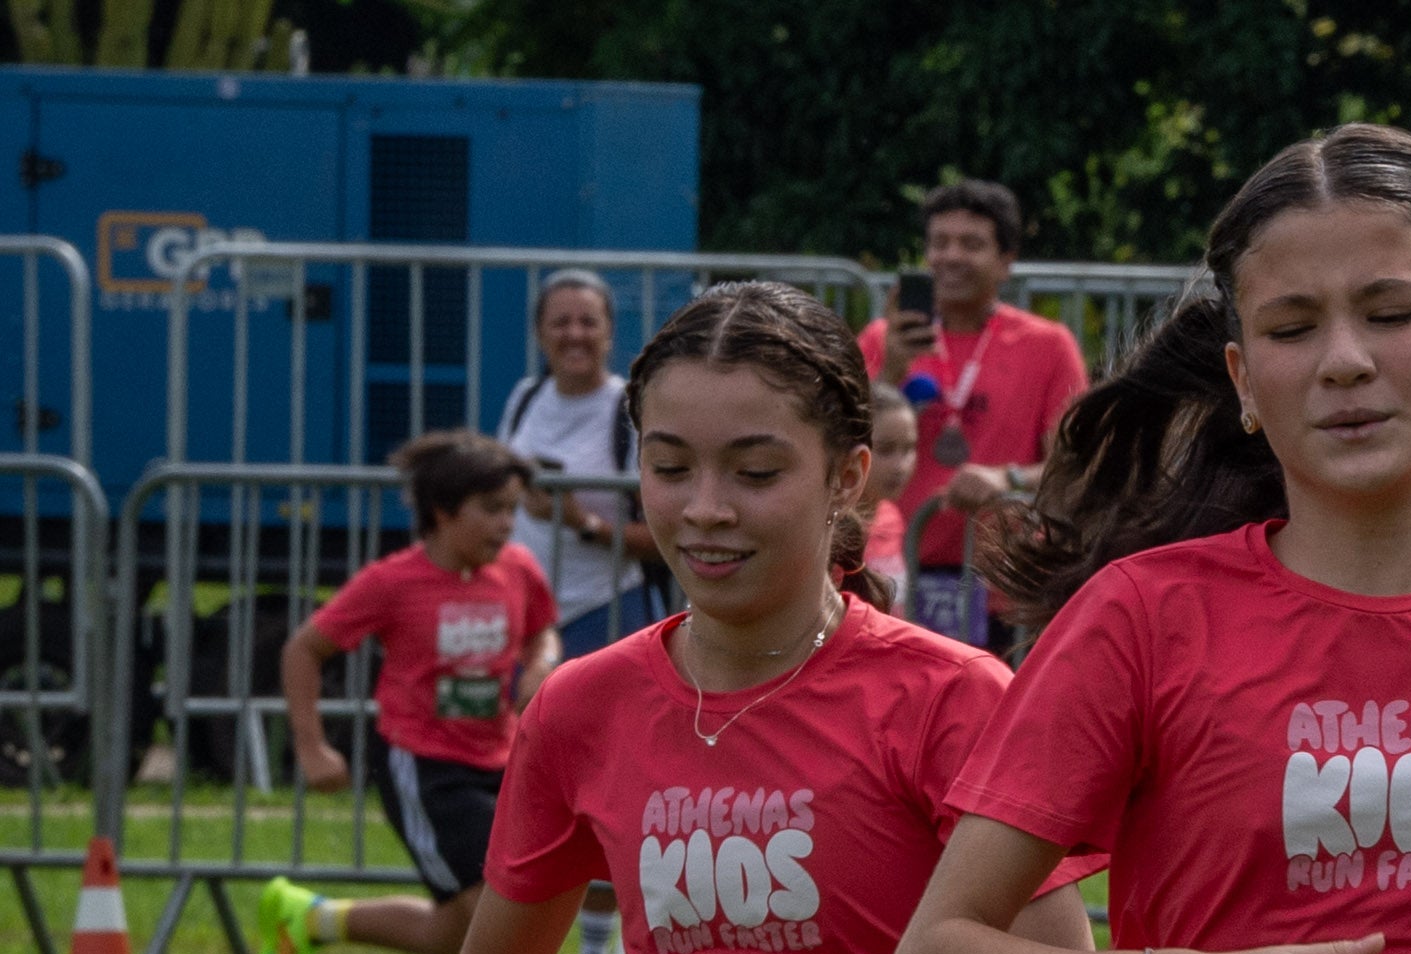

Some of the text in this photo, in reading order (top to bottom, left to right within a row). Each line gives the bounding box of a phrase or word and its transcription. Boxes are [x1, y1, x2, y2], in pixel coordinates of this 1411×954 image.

[641, 786, 815, 837] ATHENAS
[639, 828, 820, 932] KIDS
[1287, 850, 1364, 893] RUN
[719, 921, 822, 953] FASTER
